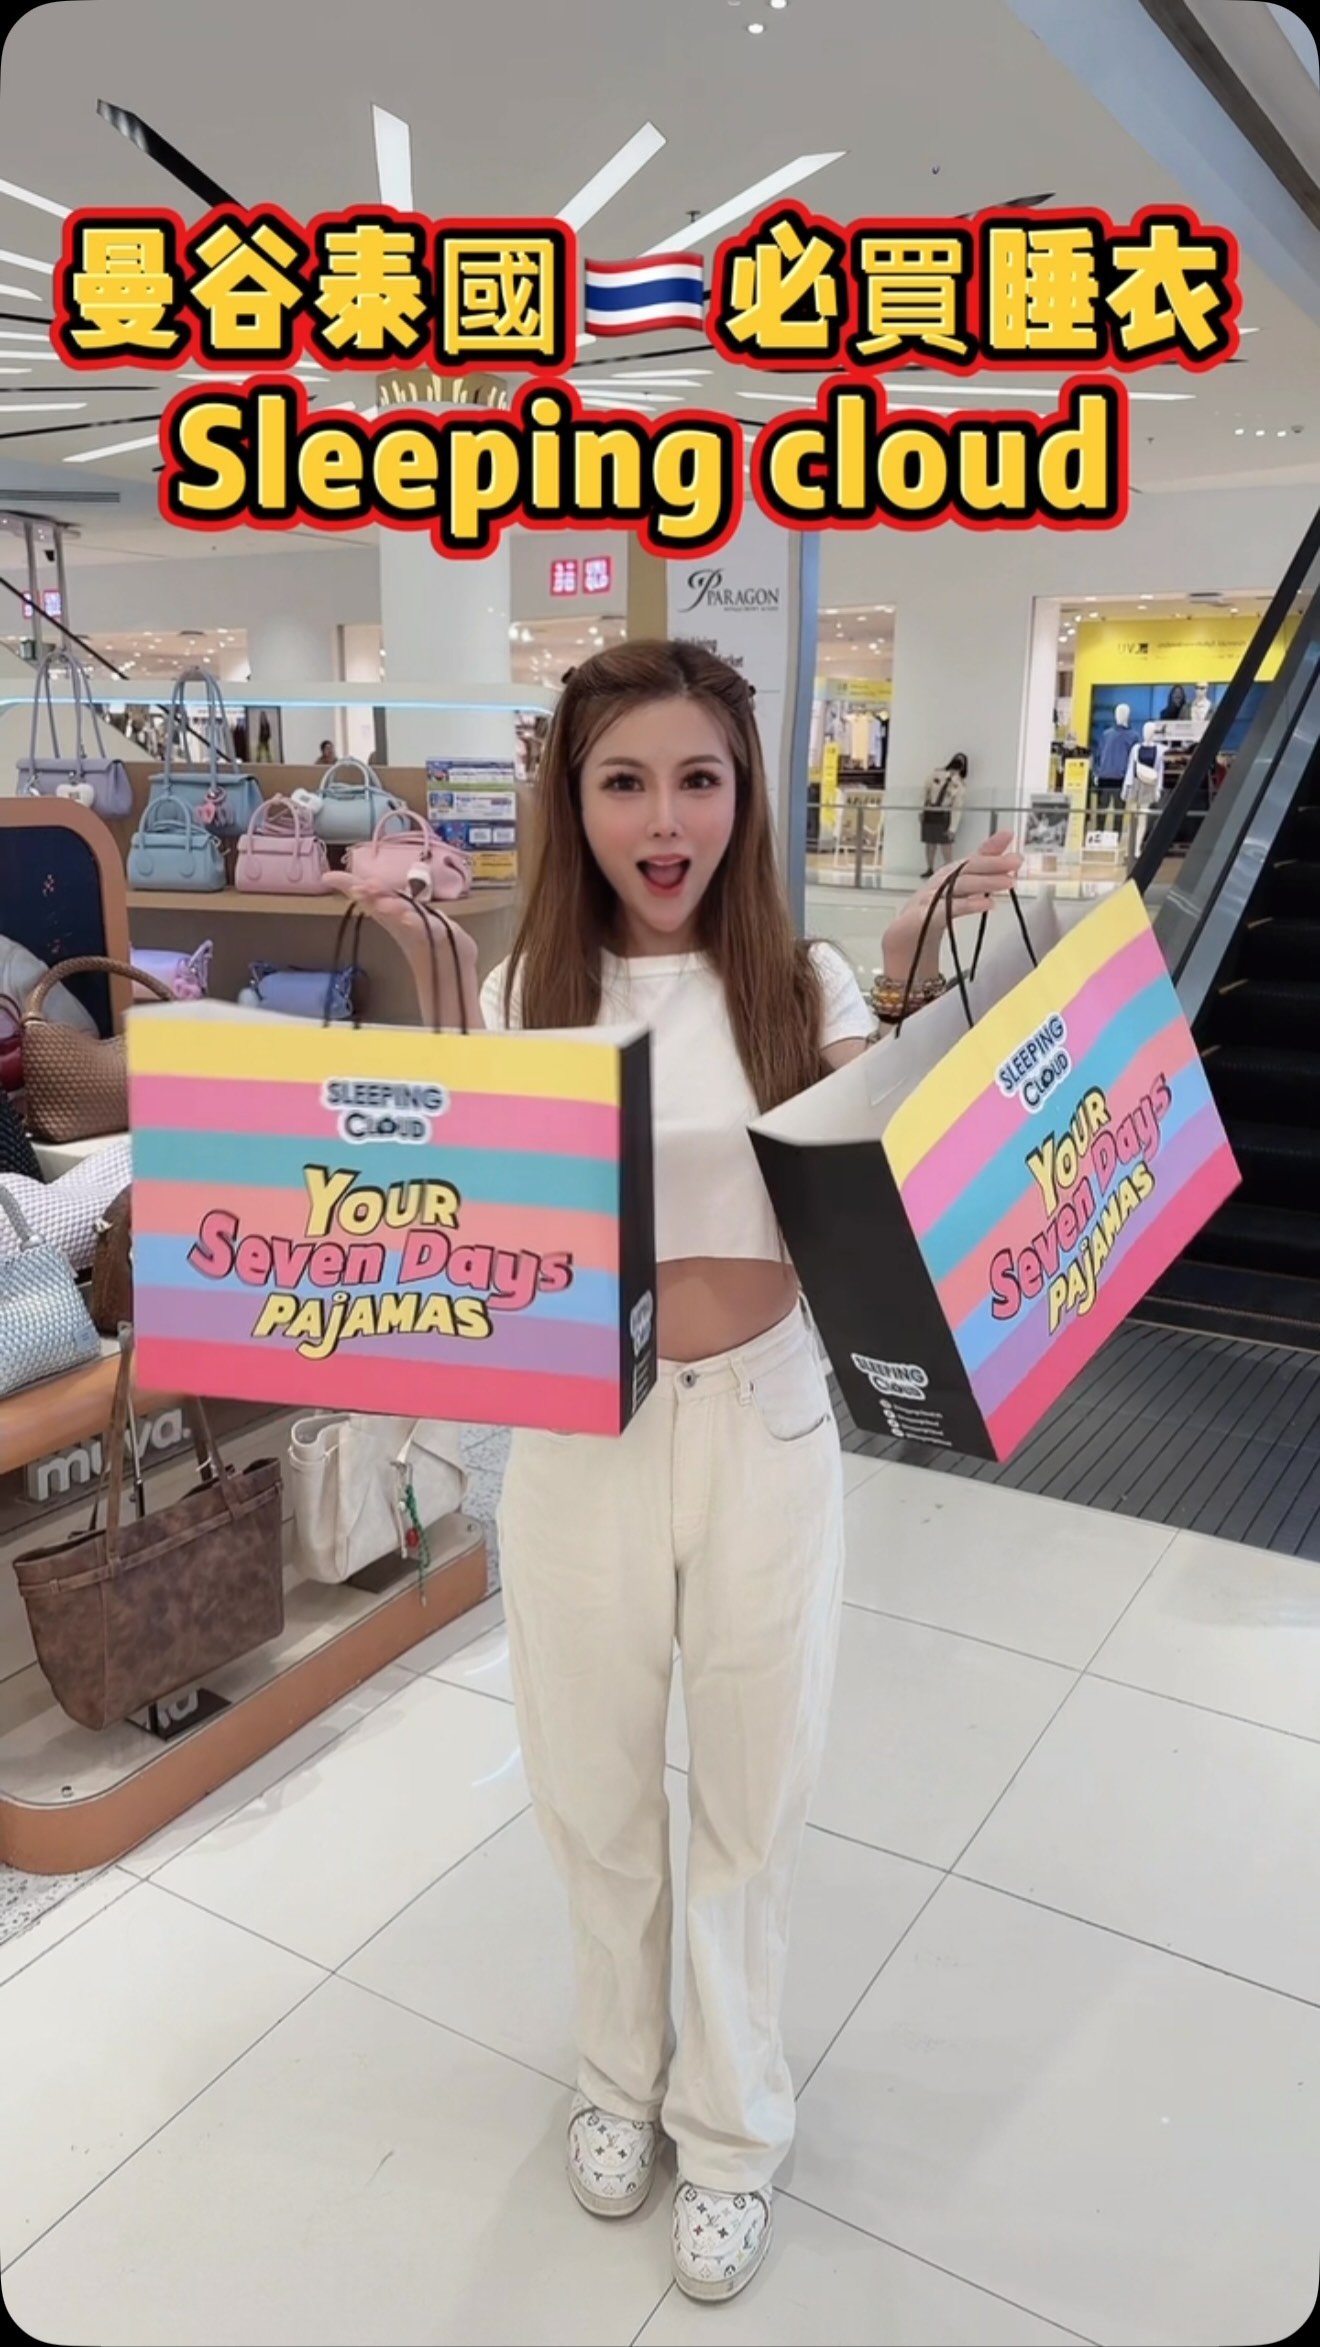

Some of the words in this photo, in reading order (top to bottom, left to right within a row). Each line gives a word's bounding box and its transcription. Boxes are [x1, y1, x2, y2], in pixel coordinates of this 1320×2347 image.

[706, 587, 779, 607] PARAGON
[998, 1016, 1065, 1092] SLEEPING
[1023, 1050, 1070, 1107] CLOUD
[327, 1081, 443, 1111] SLEEPING
[345, 1112, 426, 1138] CLOUD
[1026, 1085, 1112, 1216] YOUR
[302, 1164, 461, 1239] YOUR
[989, 1185, 1098, 1320] Seven
[1090, 1073, 1173, 1194] Days
[188, 1210, 385, 1289] Seven
[396, 1228, 574, 1311] Days
